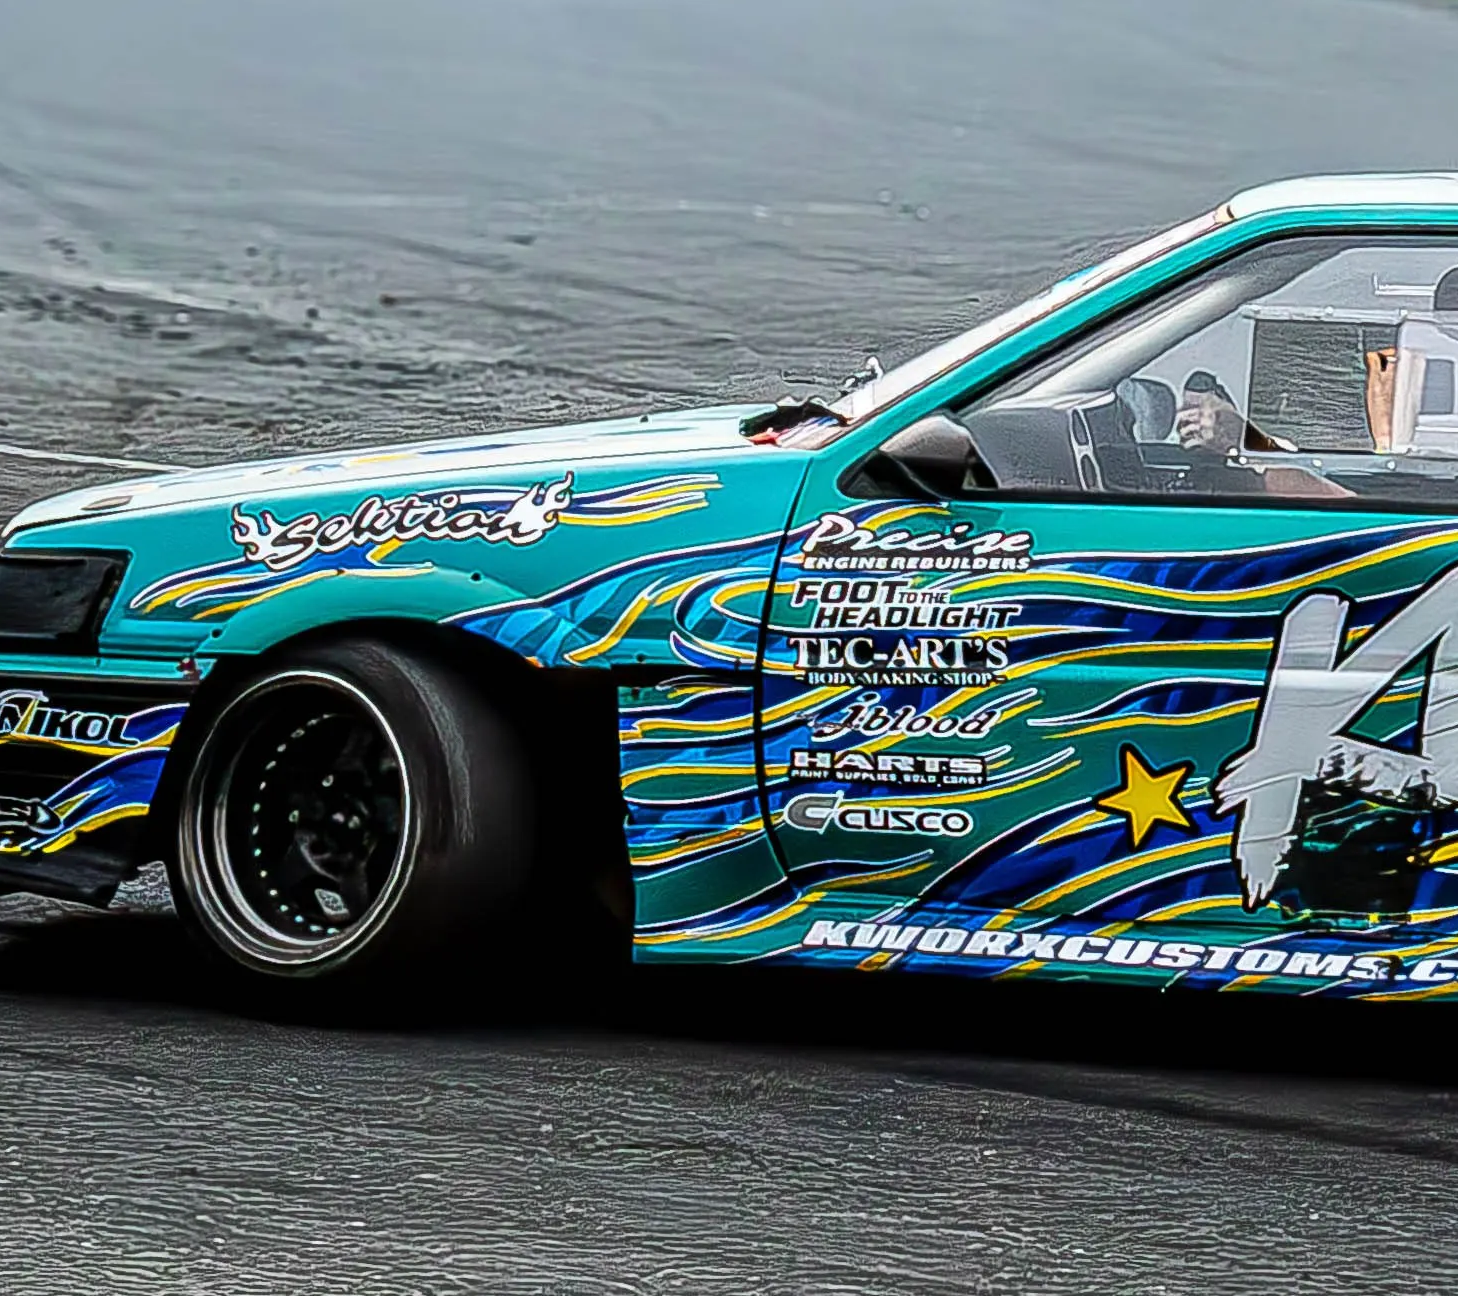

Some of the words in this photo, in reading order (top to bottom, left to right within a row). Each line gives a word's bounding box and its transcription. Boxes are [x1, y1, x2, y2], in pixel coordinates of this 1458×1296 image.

[803, 514, 1031, 554] Precise
[804, 557, 887, 569] ENGINE
[892, 557, 1030, 570] REBUILDERS
[794, 580, 910, 605] FOOT
[899, 592, 918, 603] TO
[920, 592, 948, 604] THE
[813, 606, 1020, 629] HEADLIGHT
[794, 751, 984, 774] HARTS
